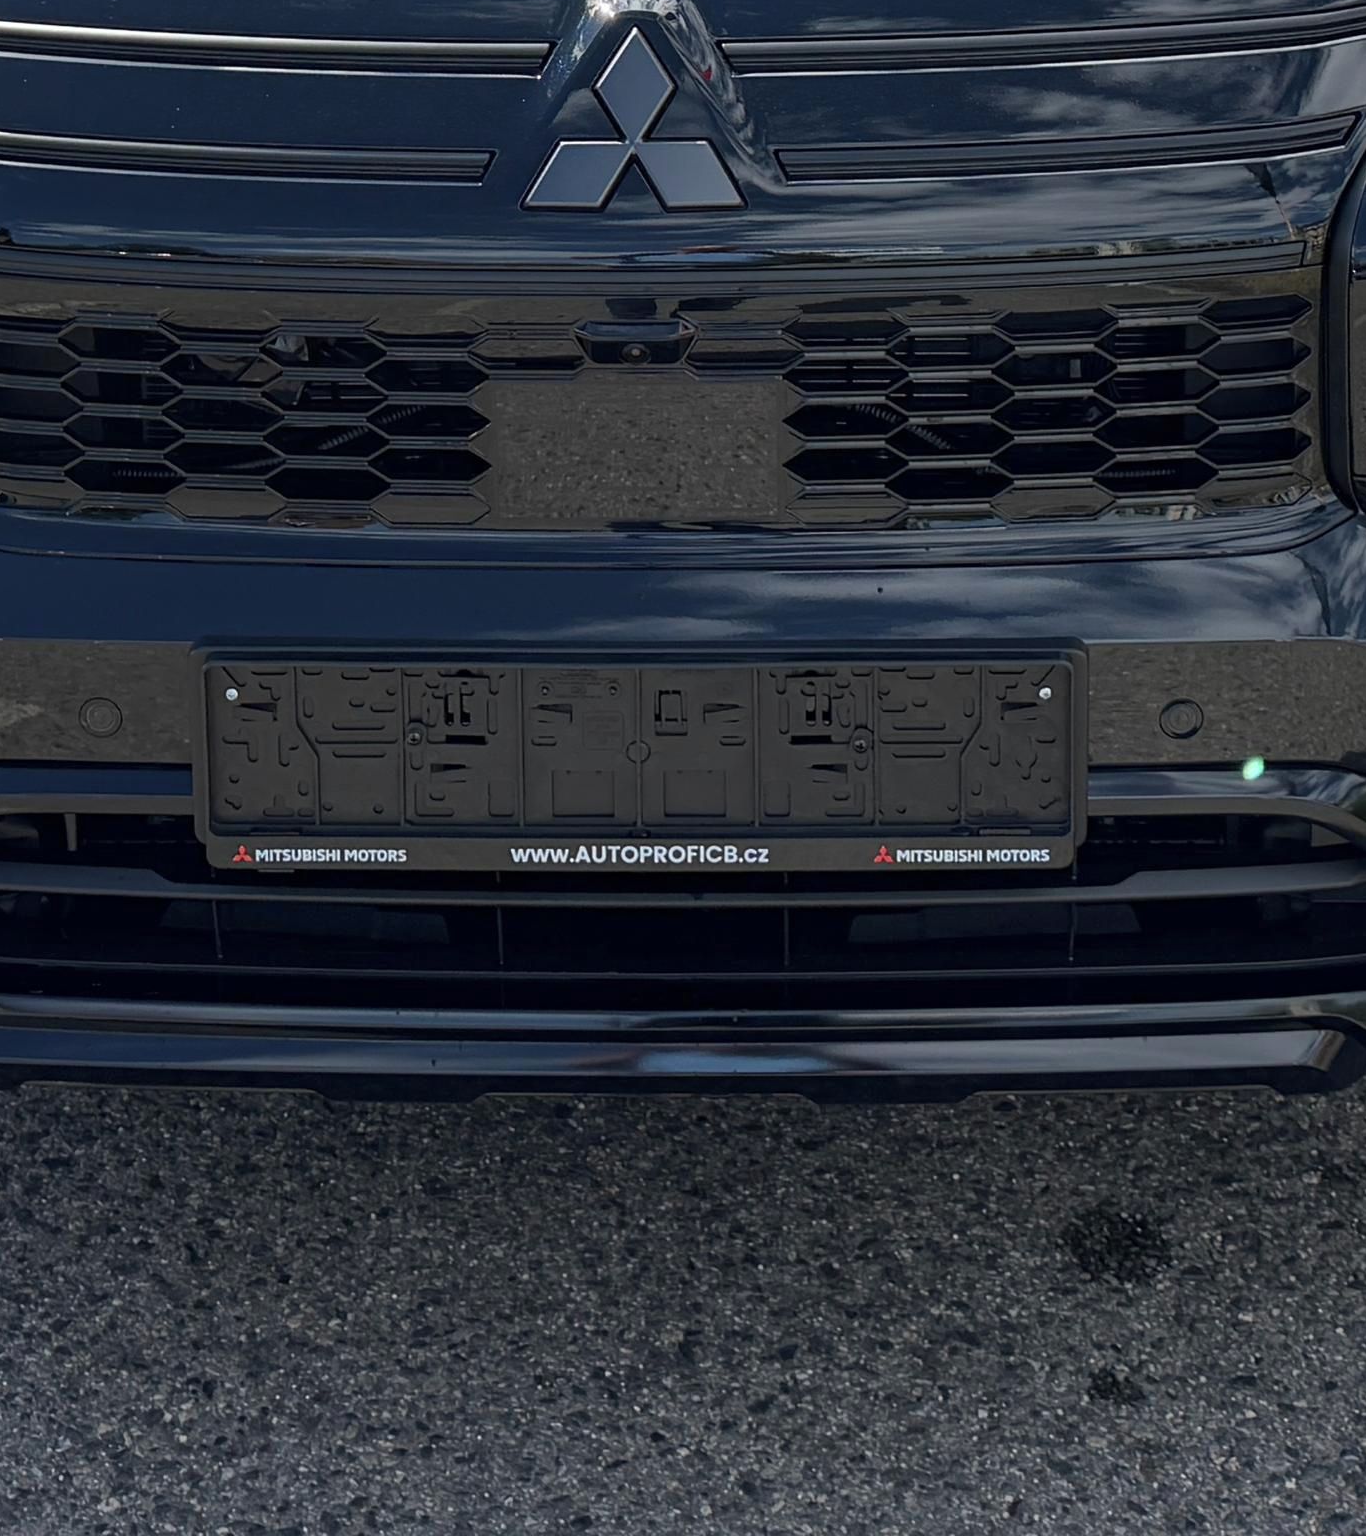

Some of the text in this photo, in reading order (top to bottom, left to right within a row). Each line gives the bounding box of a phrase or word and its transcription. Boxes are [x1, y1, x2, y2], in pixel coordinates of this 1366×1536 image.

[255, 848, 408, 862] MITSUBISHI MOTORS
[510, 845, 770, 864] www.AUTOPROFICB.cz
[896, 848, 1050, 863] MITSUBISHI MOTORS
